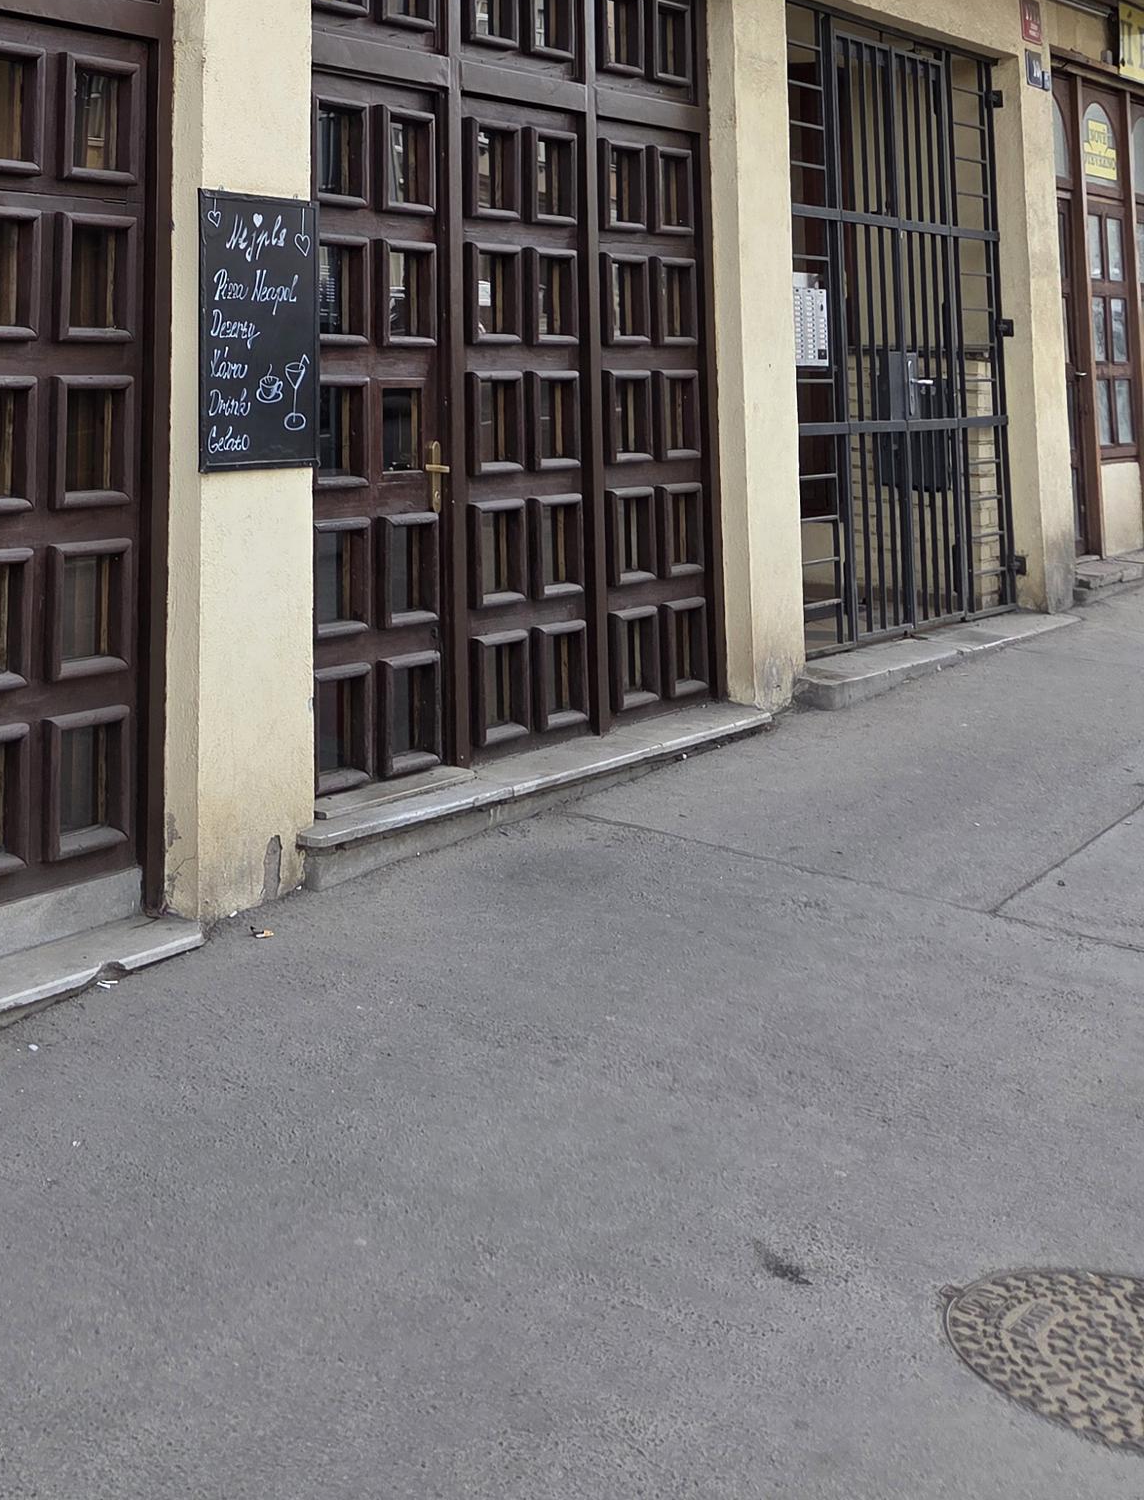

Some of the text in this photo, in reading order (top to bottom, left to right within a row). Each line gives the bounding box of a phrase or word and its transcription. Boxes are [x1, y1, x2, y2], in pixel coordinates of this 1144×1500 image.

[225, 213, 287, 262] Nejpls
[213, 268, 298, 315] Pizza Neapol
[210, 309, 260, 349] Dezerty
[210, 347, 248, 380] Káva
[208, 388, 251, 417] Drink
[208, 425, 250, 452] Gelato
